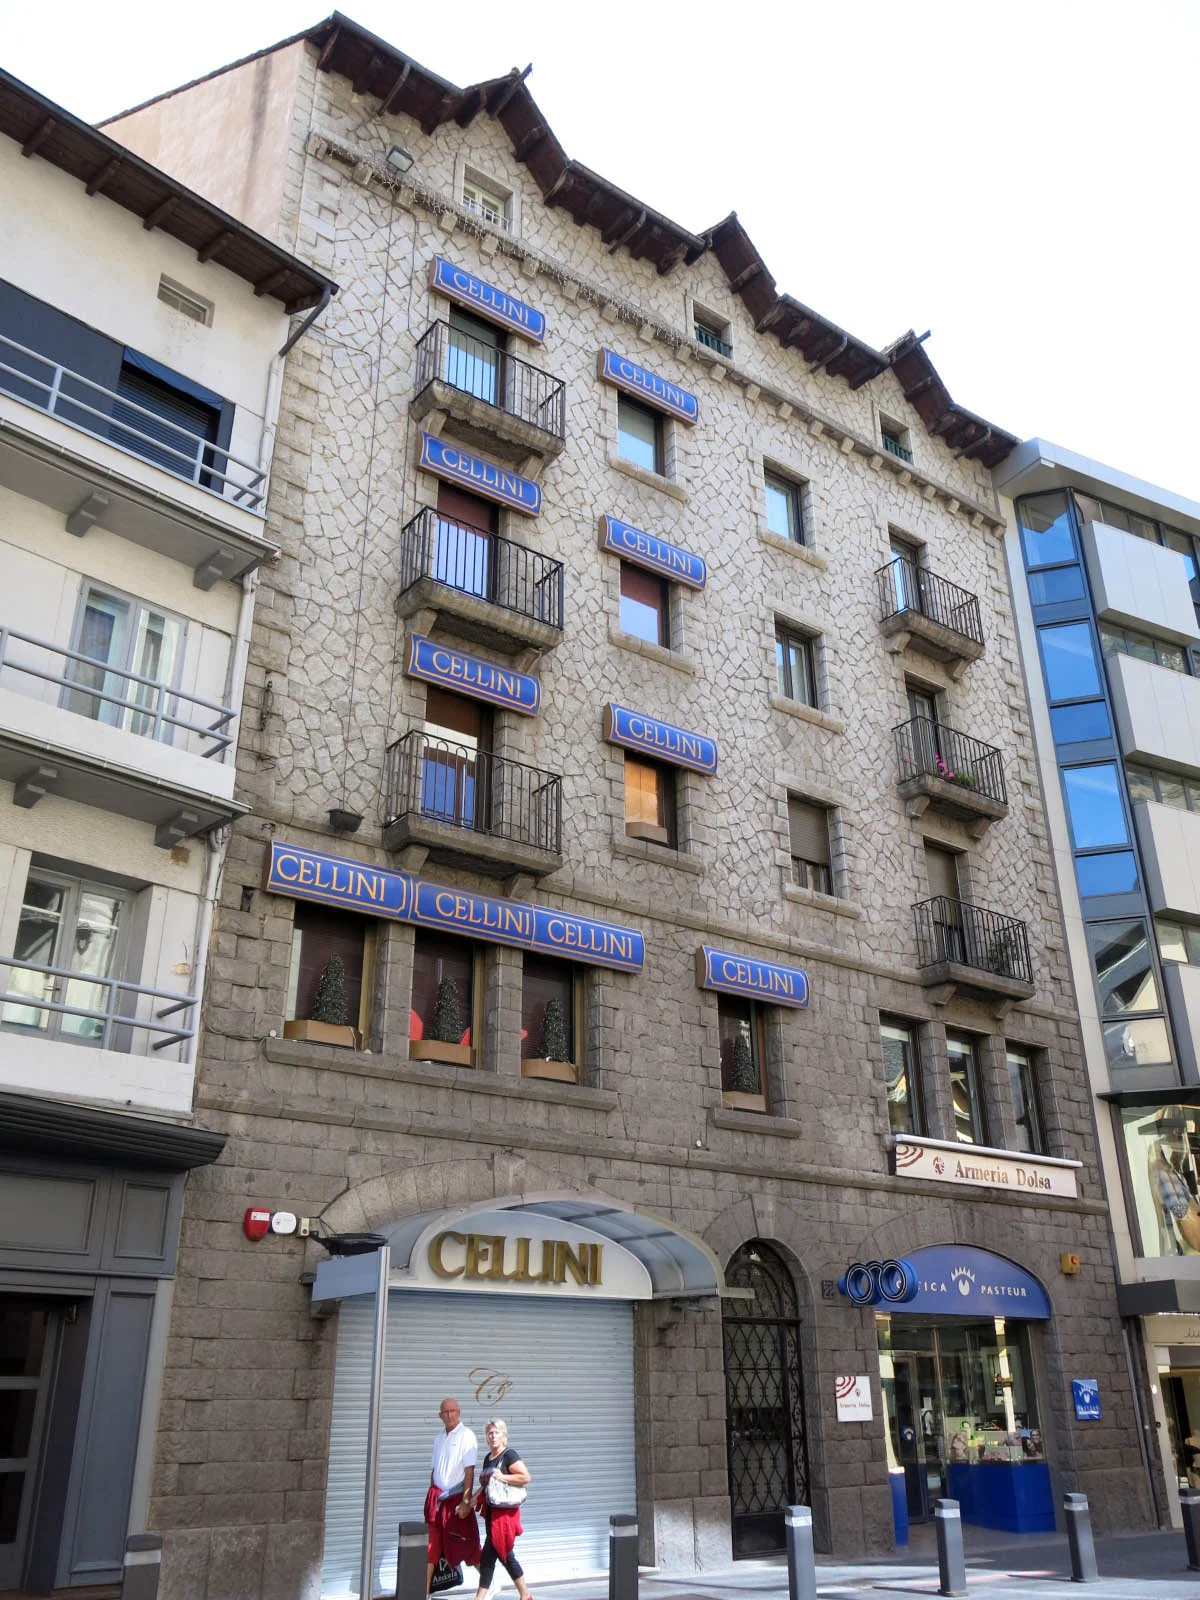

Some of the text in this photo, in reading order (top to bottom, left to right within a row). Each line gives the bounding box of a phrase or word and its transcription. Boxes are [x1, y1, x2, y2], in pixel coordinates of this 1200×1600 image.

[453, 271, 529, 326] CELLINI
[619, 360, 686, 408] CELLINI
[440, 448, 524, 499] CELLINI
[622, 529, 693, 574] CELLINI
[432, 650, 522, 699] CELLINI
[628, 718, 702, 760] CELLINI
[276, 854, 387, 902] CELLINI
[435, 892, 531, 935] CELLINI
[547, 919, 634, 960] CELLINI
[722, 960, 795, 996] CELLINI
[954, 1160, 1052, 1190] Armeria Dolsa
[428, 1230, 604, 1286] CELLINI
[981, 1285, 1027, 1297] PASTEUR
